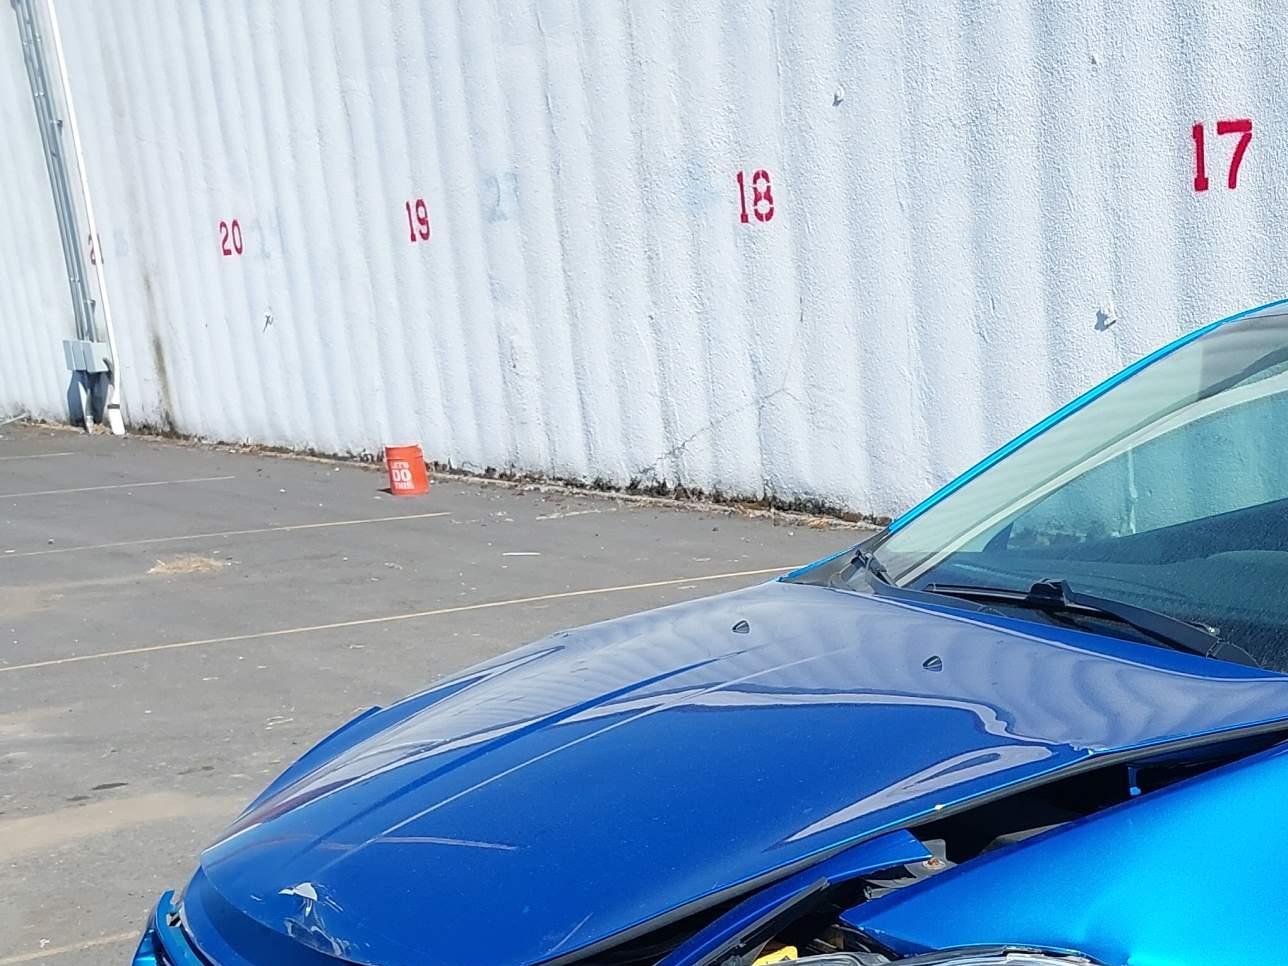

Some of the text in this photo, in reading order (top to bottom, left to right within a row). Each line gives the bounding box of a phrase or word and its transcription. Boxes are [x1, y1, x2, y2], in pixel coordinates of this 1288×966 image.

[1191, 118, 1253, 192] 17
[735, 169, 775, 224] 18
[219, 218, 243, 257] 20
[407, 199, 430, 242] 19
[392, 469, 412, 482] DO
